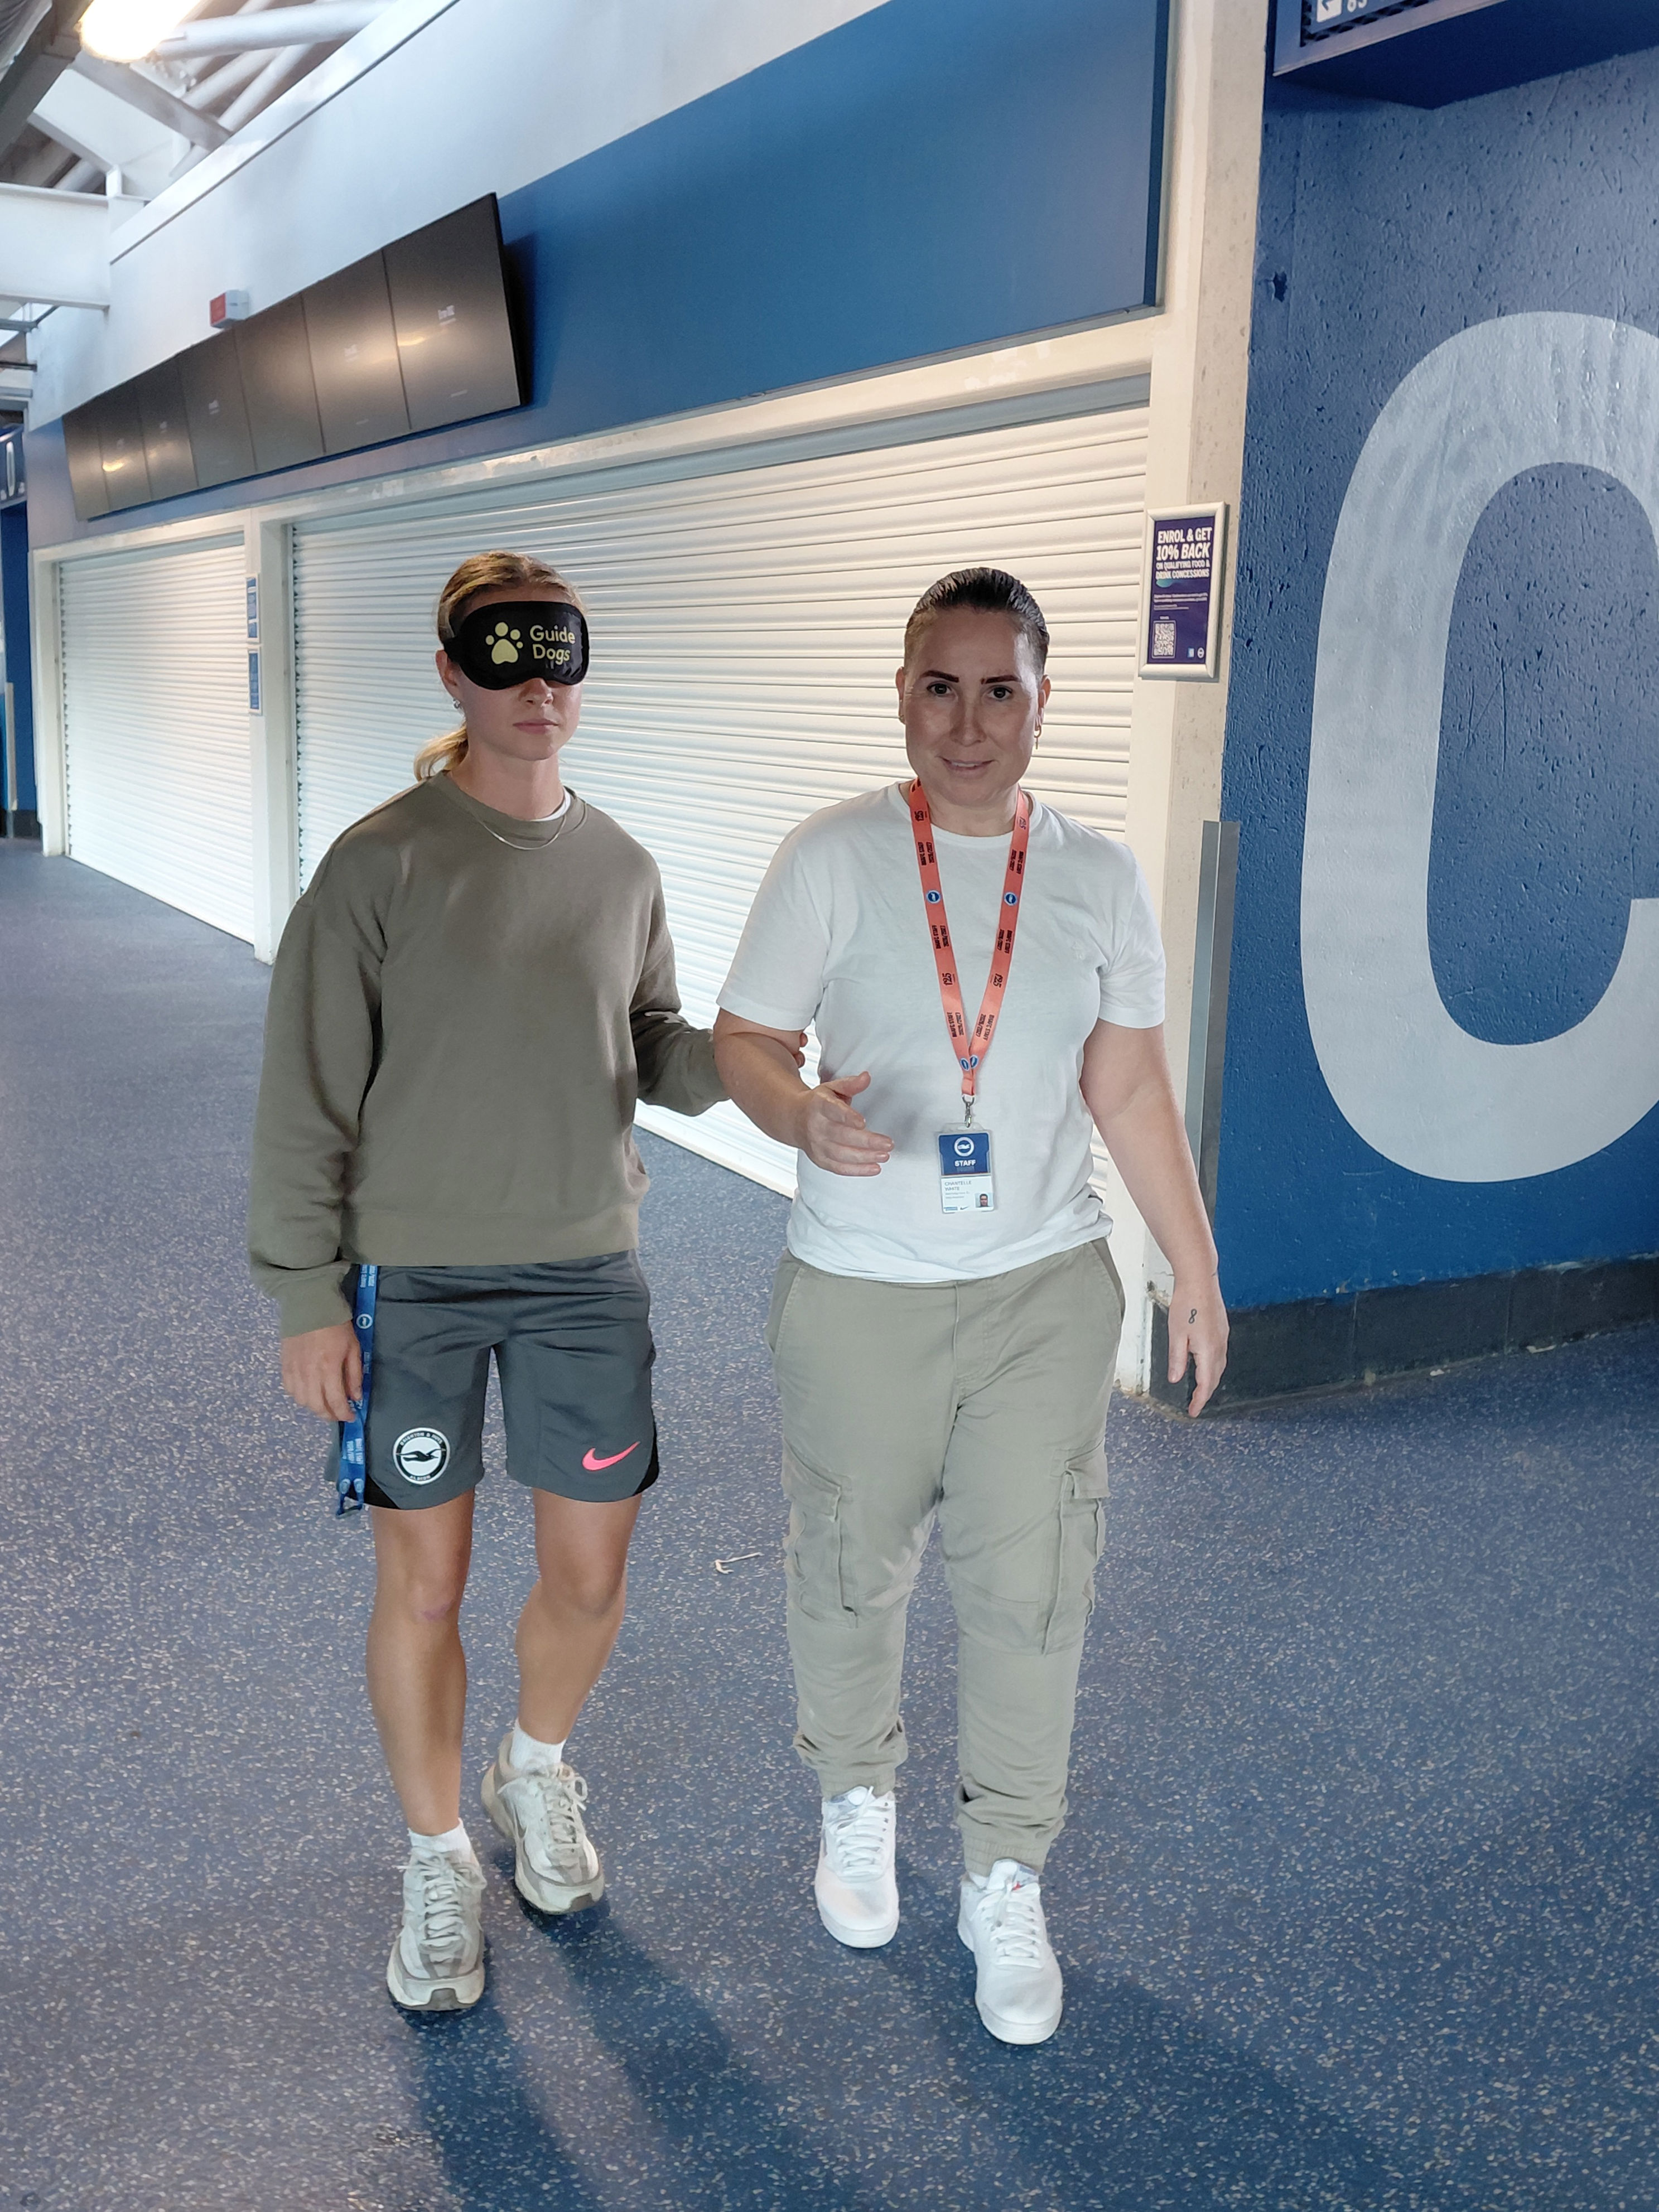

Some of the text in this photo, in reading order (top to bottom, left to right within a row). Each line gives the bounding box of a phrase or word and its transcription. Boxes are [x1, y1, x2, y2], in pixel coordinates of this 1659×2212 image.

[1158, 527, 1213, 544] ENROL & GET
[1156, 542, 1211, 561] 10% BACK
[1172, 569, 1209, 579] CONCESSIONS
[530, 625, 576, 644] Guide
[532, 644, 571, 665] Dogs
[942, 972, 953, 986] 125
[993, 973, 1004, 988] 125
